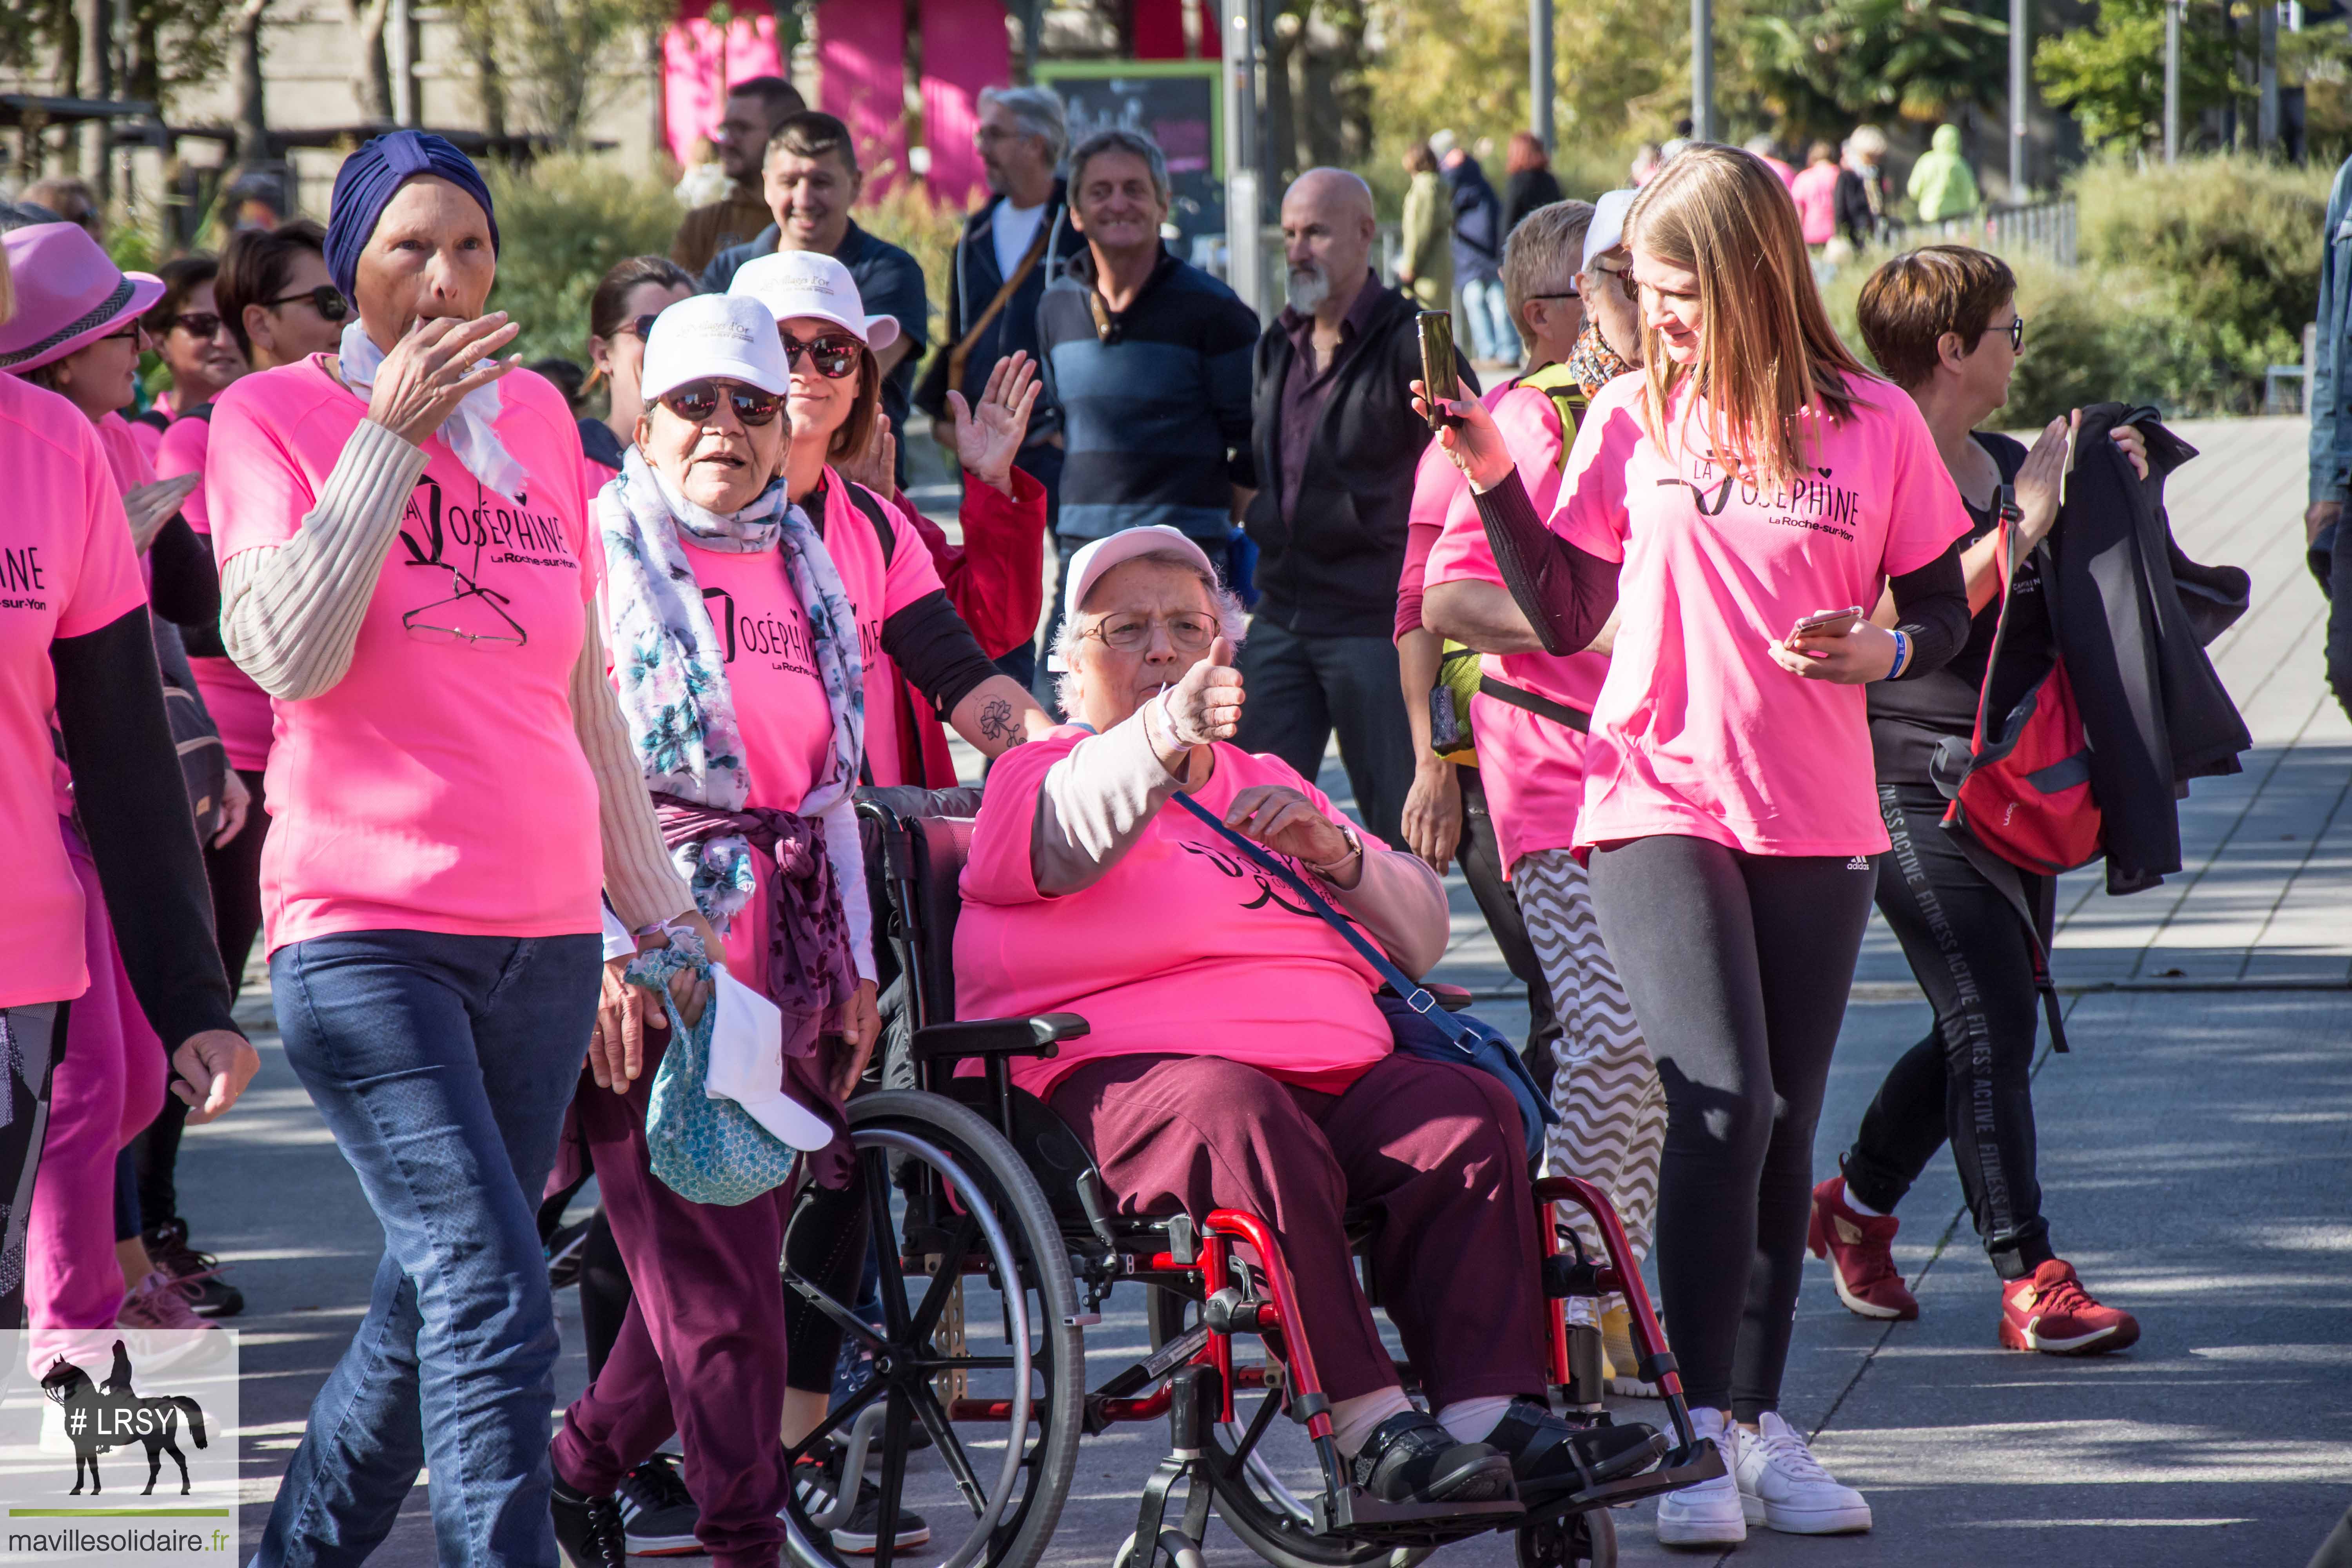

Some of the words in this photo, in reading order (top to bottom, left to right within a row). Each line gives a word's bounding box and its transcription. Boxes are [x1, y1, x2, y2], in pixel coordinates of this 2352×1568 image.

[1694, 460, 1712, 480] LA
[402, 502, 418, 520] A
[1769, 516, 1780, 524] La
[1782, 516, 1855, 543] Roche-sur-Yon
[491, 555, 503, 563] La
[505, 553, 577, 569] Roche-sur-Yon
[1847, 862, 1869, 870] adidas
[1890, 831, 1925, 885] ACTIVE
[1916, 889, 1958, 951] FITNESS
[1945, 953, 1980, 1006] ACTIVE
[1973, 1079, 1995, 1134] ACTIVE
[1978, 1143, 2008, 1205] FITNESS
